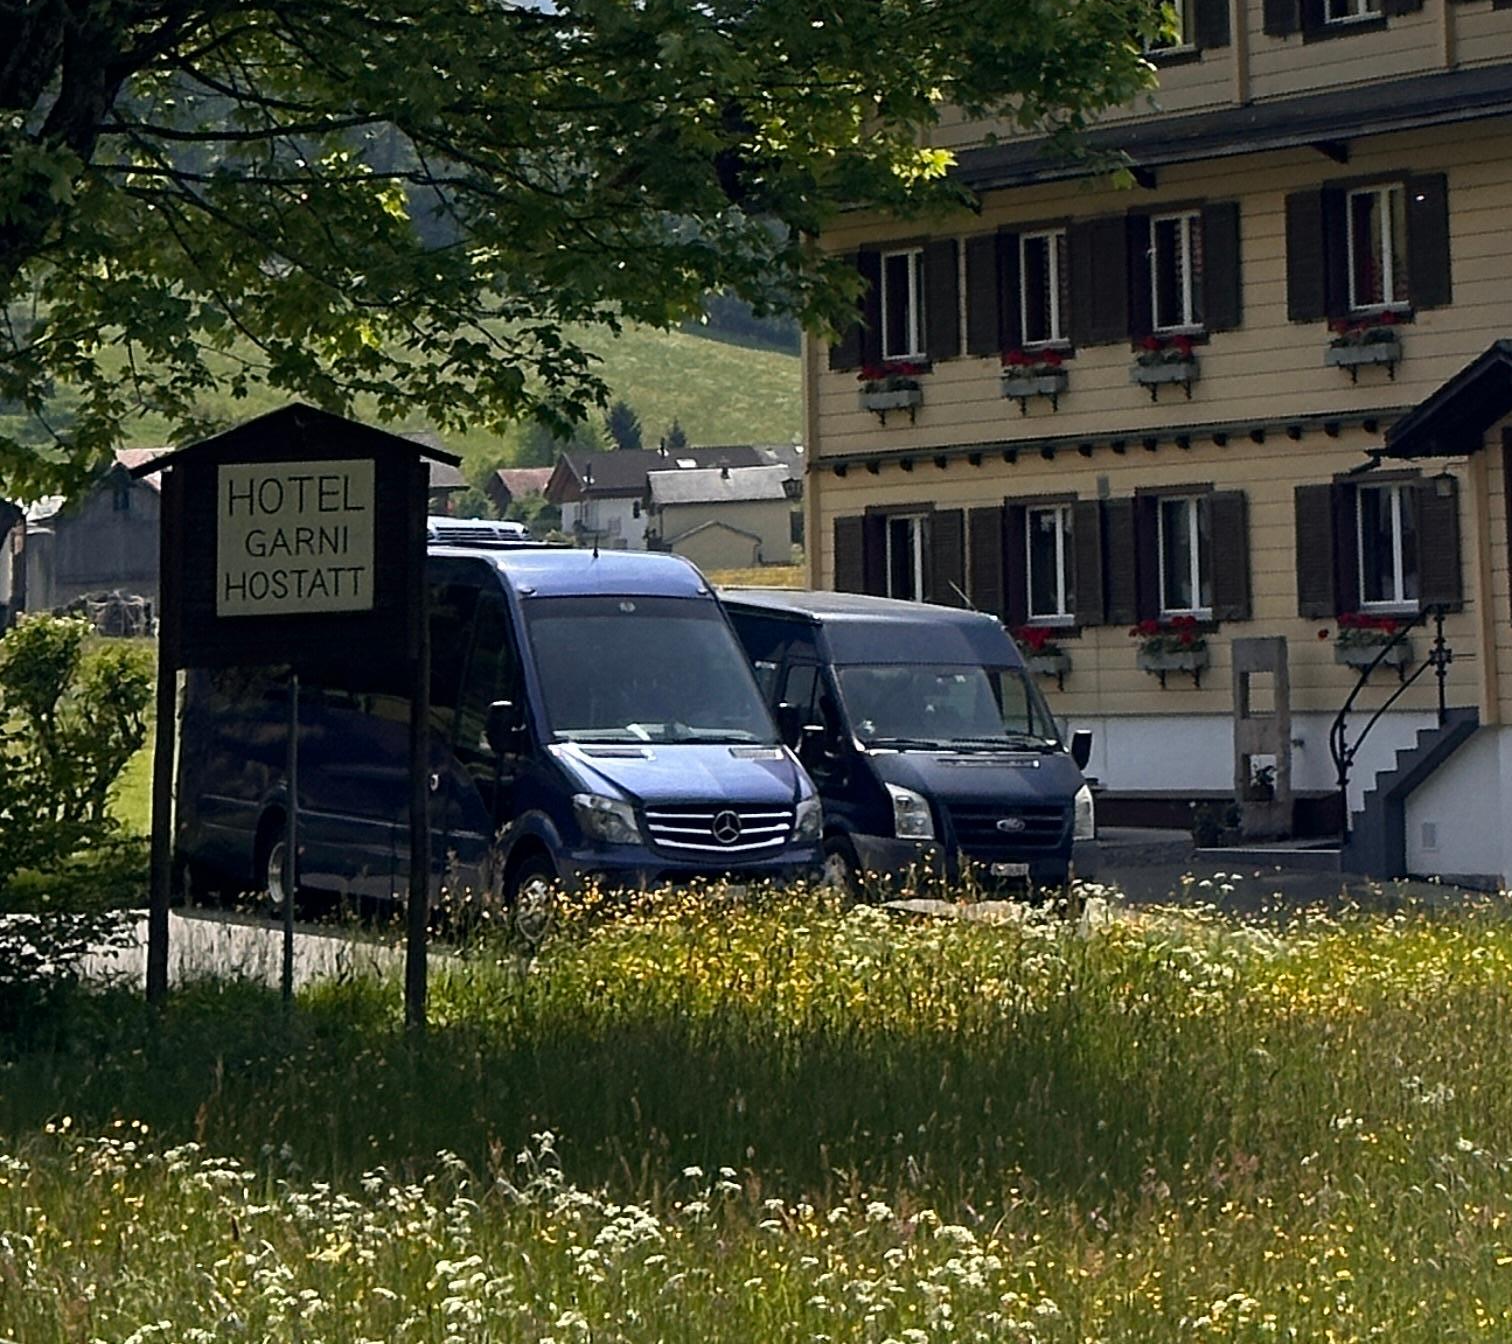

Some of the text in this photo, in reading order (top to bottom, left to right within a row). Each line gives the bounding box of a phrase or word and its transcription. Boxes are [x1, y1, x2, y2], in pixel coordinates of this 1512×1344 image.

[228, 475, 366, 516] HOTEL
[245, 526, 349, 558] GARNI
[225, 566, 365, 601] HOSTATT
